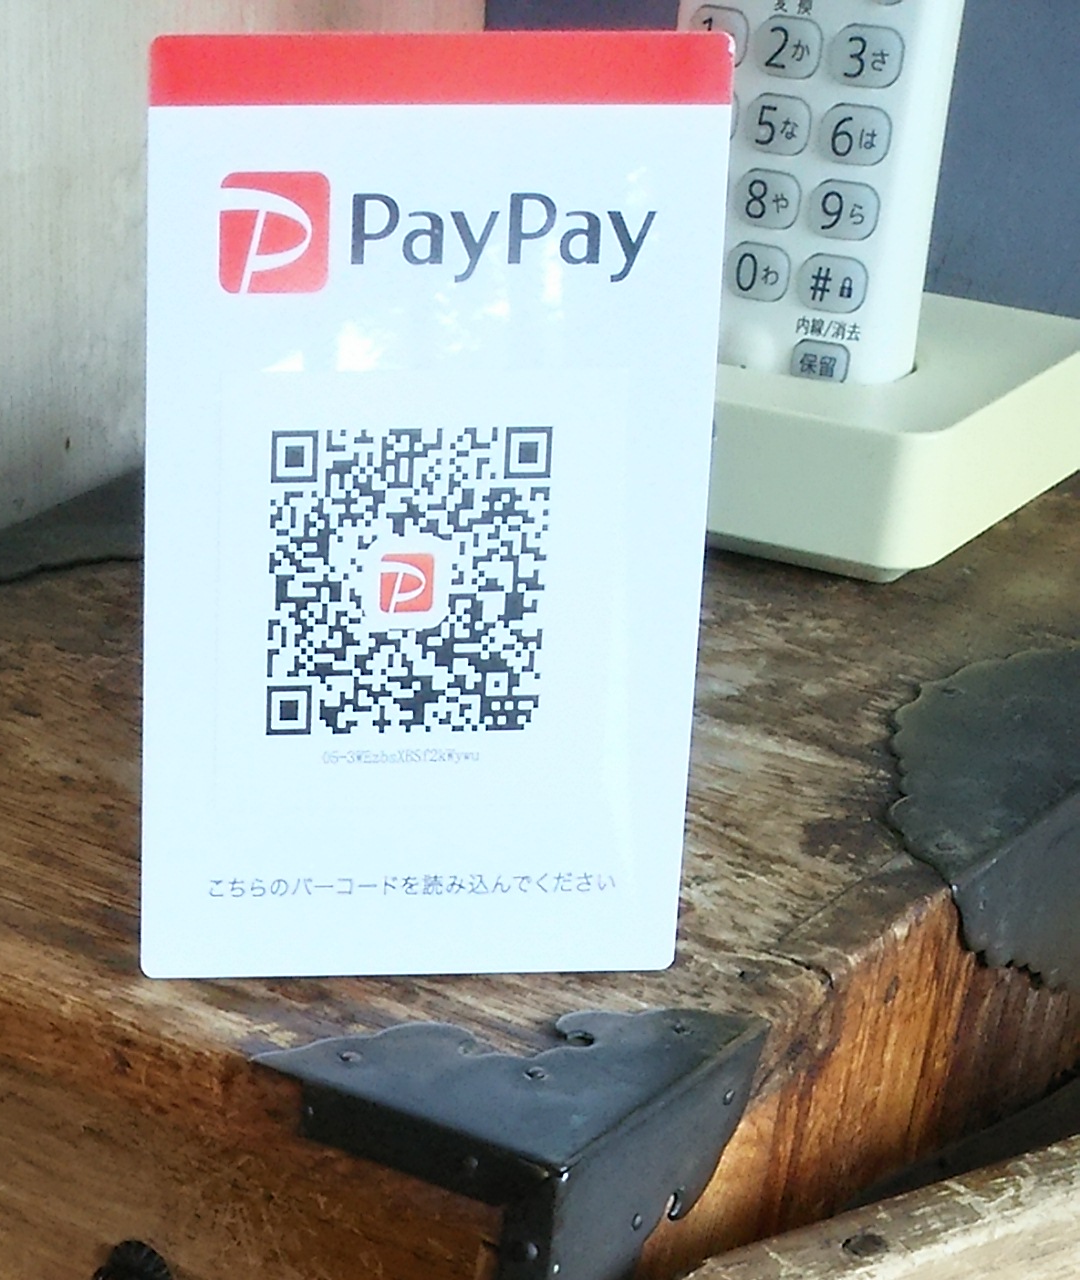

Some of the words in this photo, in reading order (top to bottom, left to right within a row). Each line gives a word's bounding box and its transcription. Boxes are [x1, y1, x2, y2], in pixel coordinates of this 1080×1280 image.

[350, 192, 657, 283] PayPay
[795, 316, 861, 342] 内線/消去
[799, 353, 837, 378] 保留
[207, 872, 617, 898] こちらのバーコードを読み込んでください
